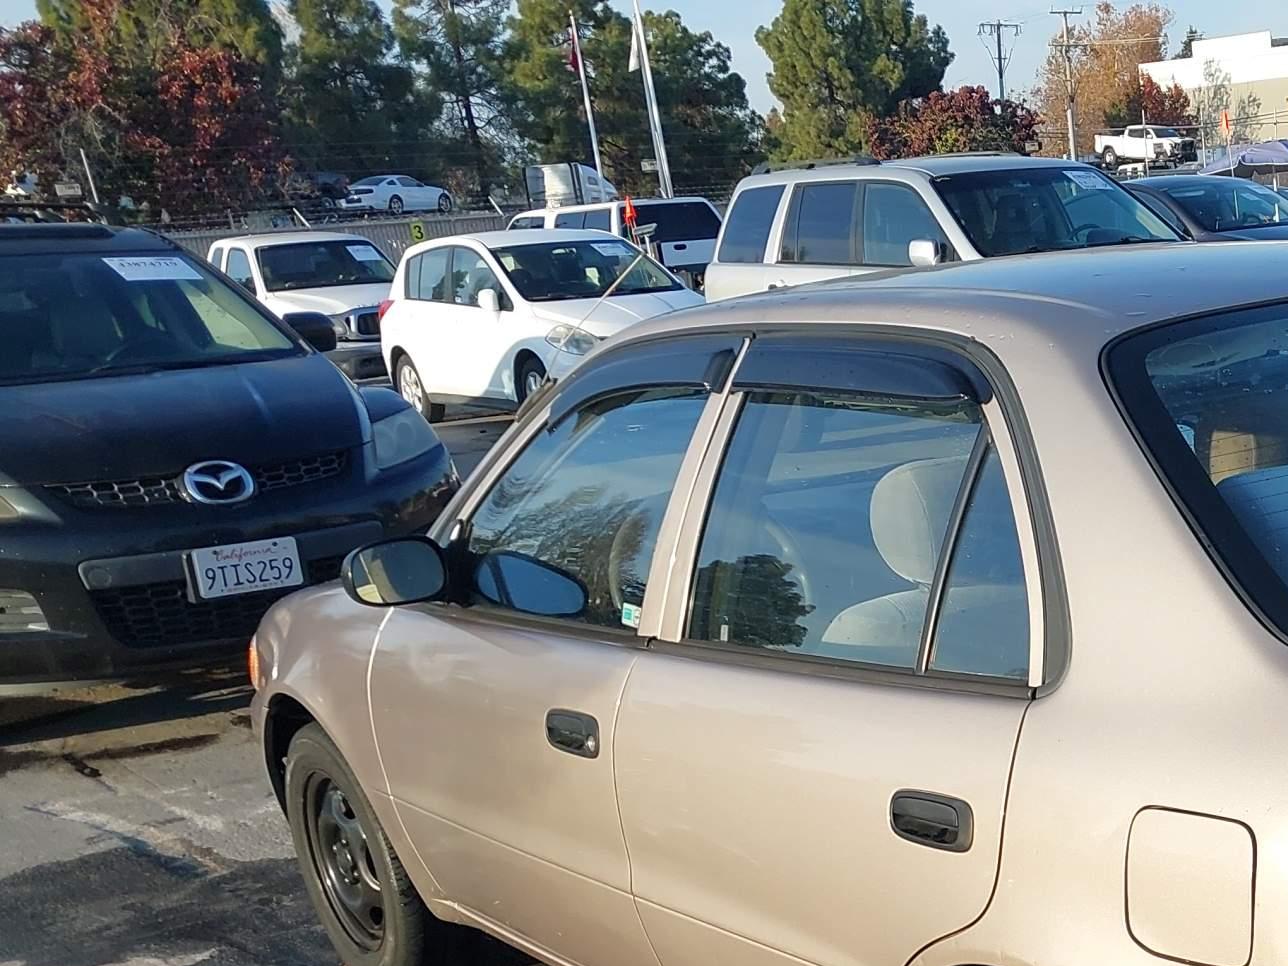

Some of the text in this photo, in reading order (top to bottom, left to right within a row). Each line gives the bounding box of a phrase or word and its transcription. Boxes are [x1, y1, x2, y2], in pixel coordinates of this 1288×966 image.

[413, 224, 424, 240] 3
[216, 547, 275, 561] California
[205, 557, 293, 591] 9TIS259
